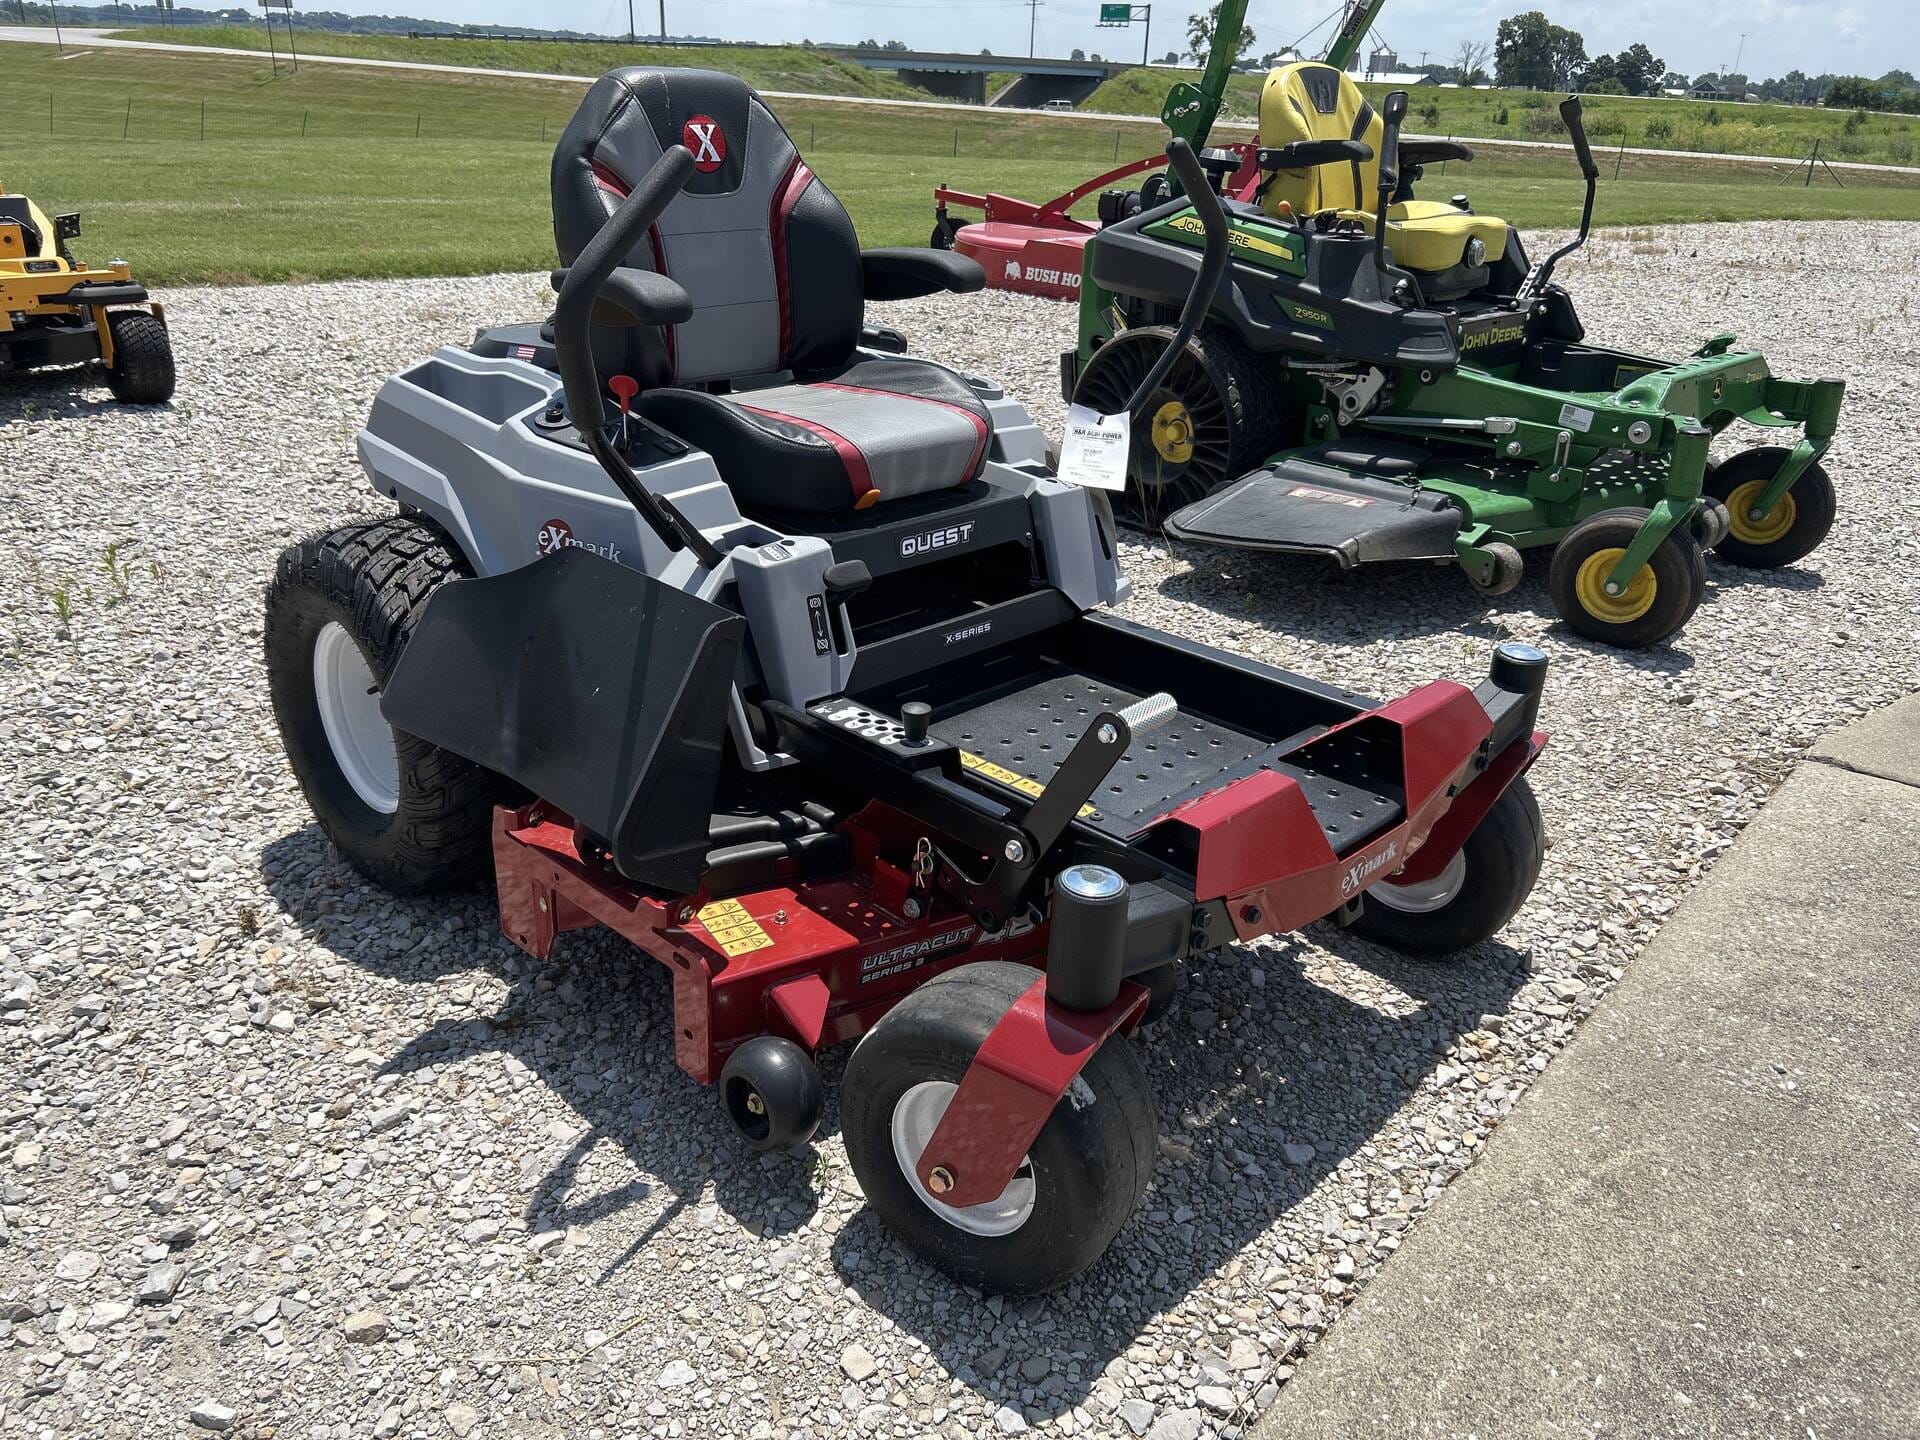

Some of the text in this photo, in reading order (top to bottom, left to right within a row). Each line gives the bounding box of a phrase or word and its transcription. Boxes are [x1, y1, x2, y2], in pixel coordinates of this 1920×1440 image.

[688, 124, 722, 162] X
[1024, 266, 1082, 288] BUSH HO
[1294, 306, 1327, 323] Z950R
[1459, 326, 1524, 352] JOHN DEERE
[900, 521, 975, 558] QUEST
[861, 924, 976, 972] ULTRACUT
[861, 962, 913, 984] SERIES
